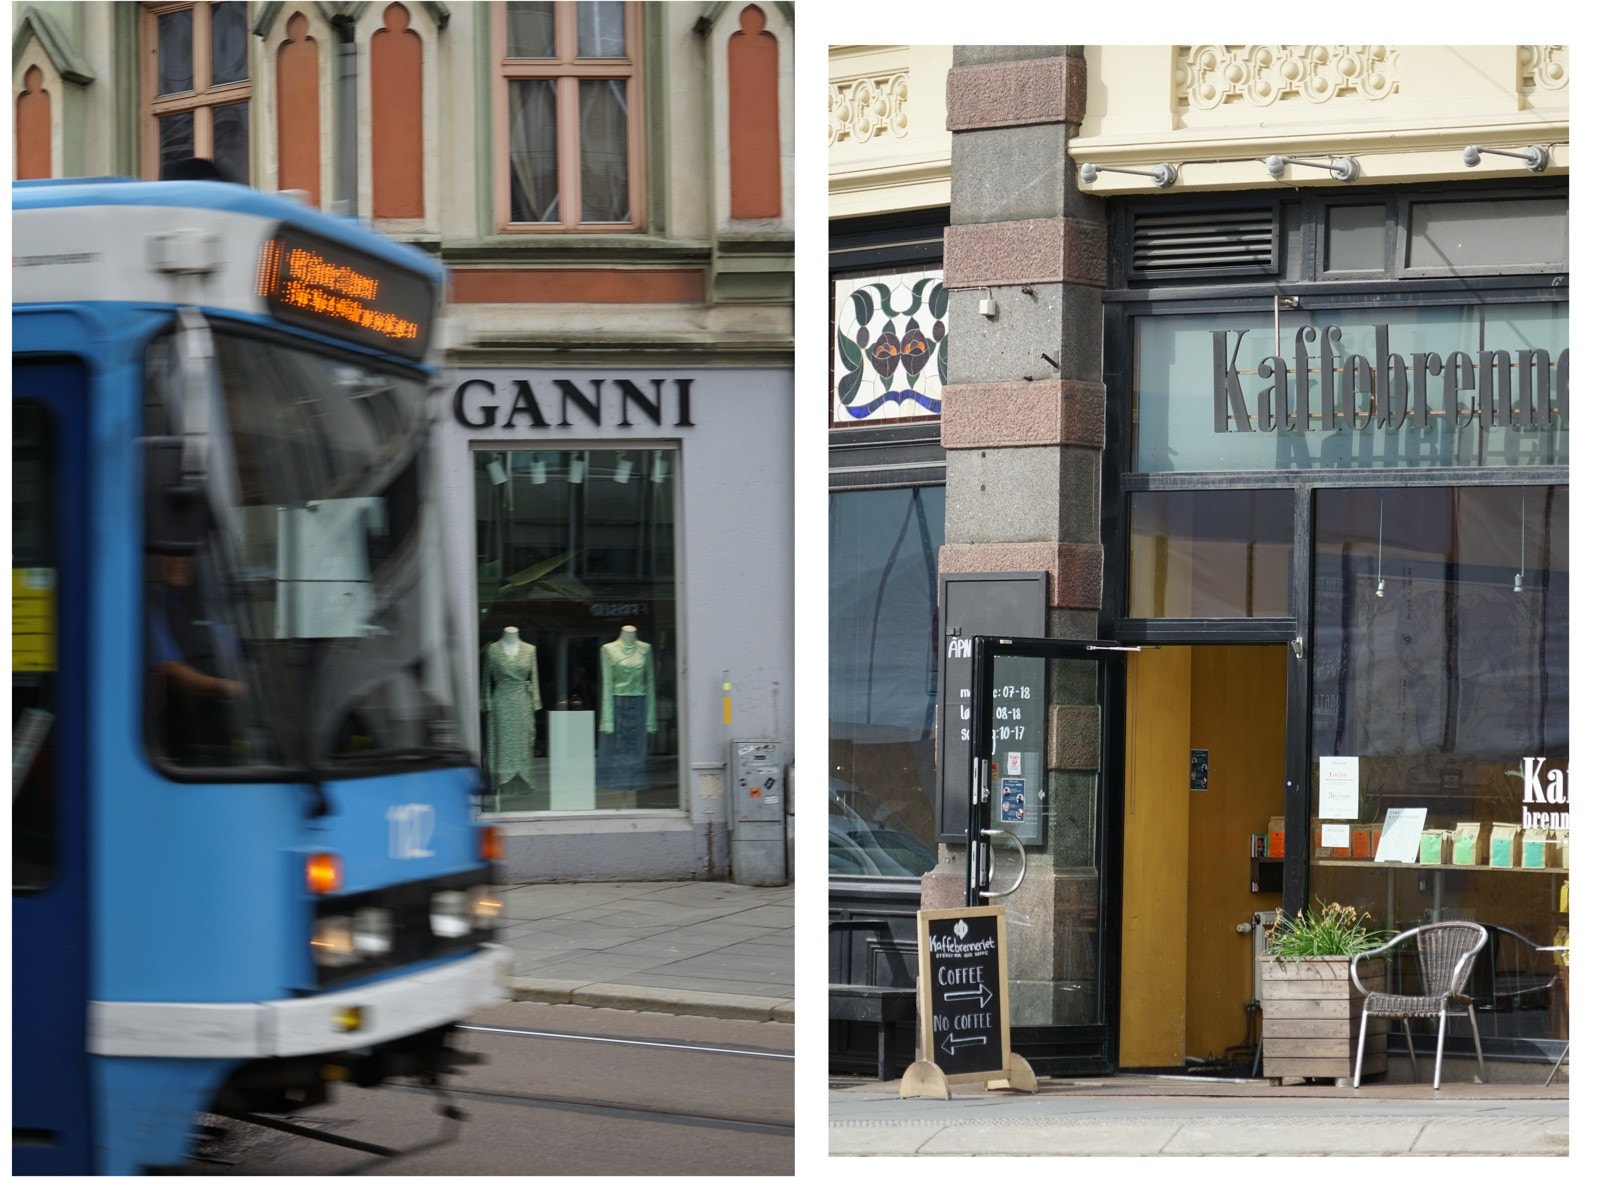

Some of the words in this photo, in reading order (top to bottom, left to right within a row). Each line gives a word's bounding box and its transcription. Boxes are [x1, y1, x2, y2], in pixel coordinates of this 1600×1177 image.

[453, 378, 696, 429] GANNI
[1002, 685, 1031, 700] 07-18
[996, 706, 1022, 721] 08-18
[1522, 756, 1569, 805] Ka
[929, 934, 996, 953] Kaffebrenneriet
[938, 965, 985, 986] COFFEE
[954, 1012, 993, 1030] COFFEE
